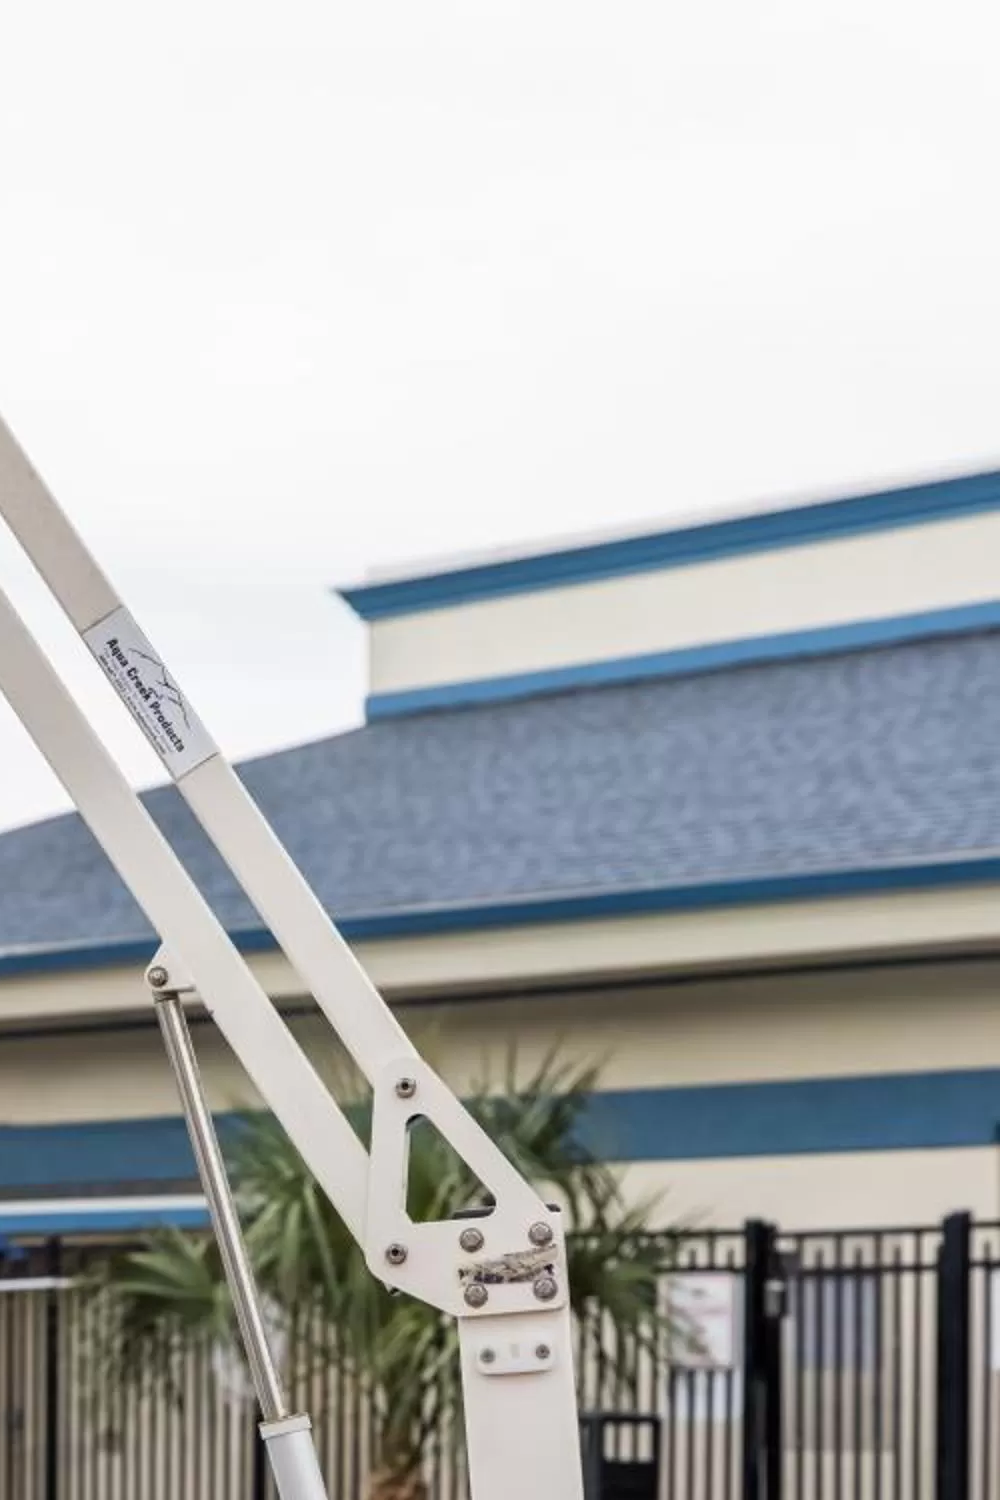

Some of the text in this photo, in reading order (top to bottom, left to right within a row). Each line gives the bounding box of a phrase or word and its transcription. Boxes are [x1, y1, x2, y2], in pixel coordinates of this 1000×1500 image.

[106, 638, 185, 753] Aqua Creek Products
